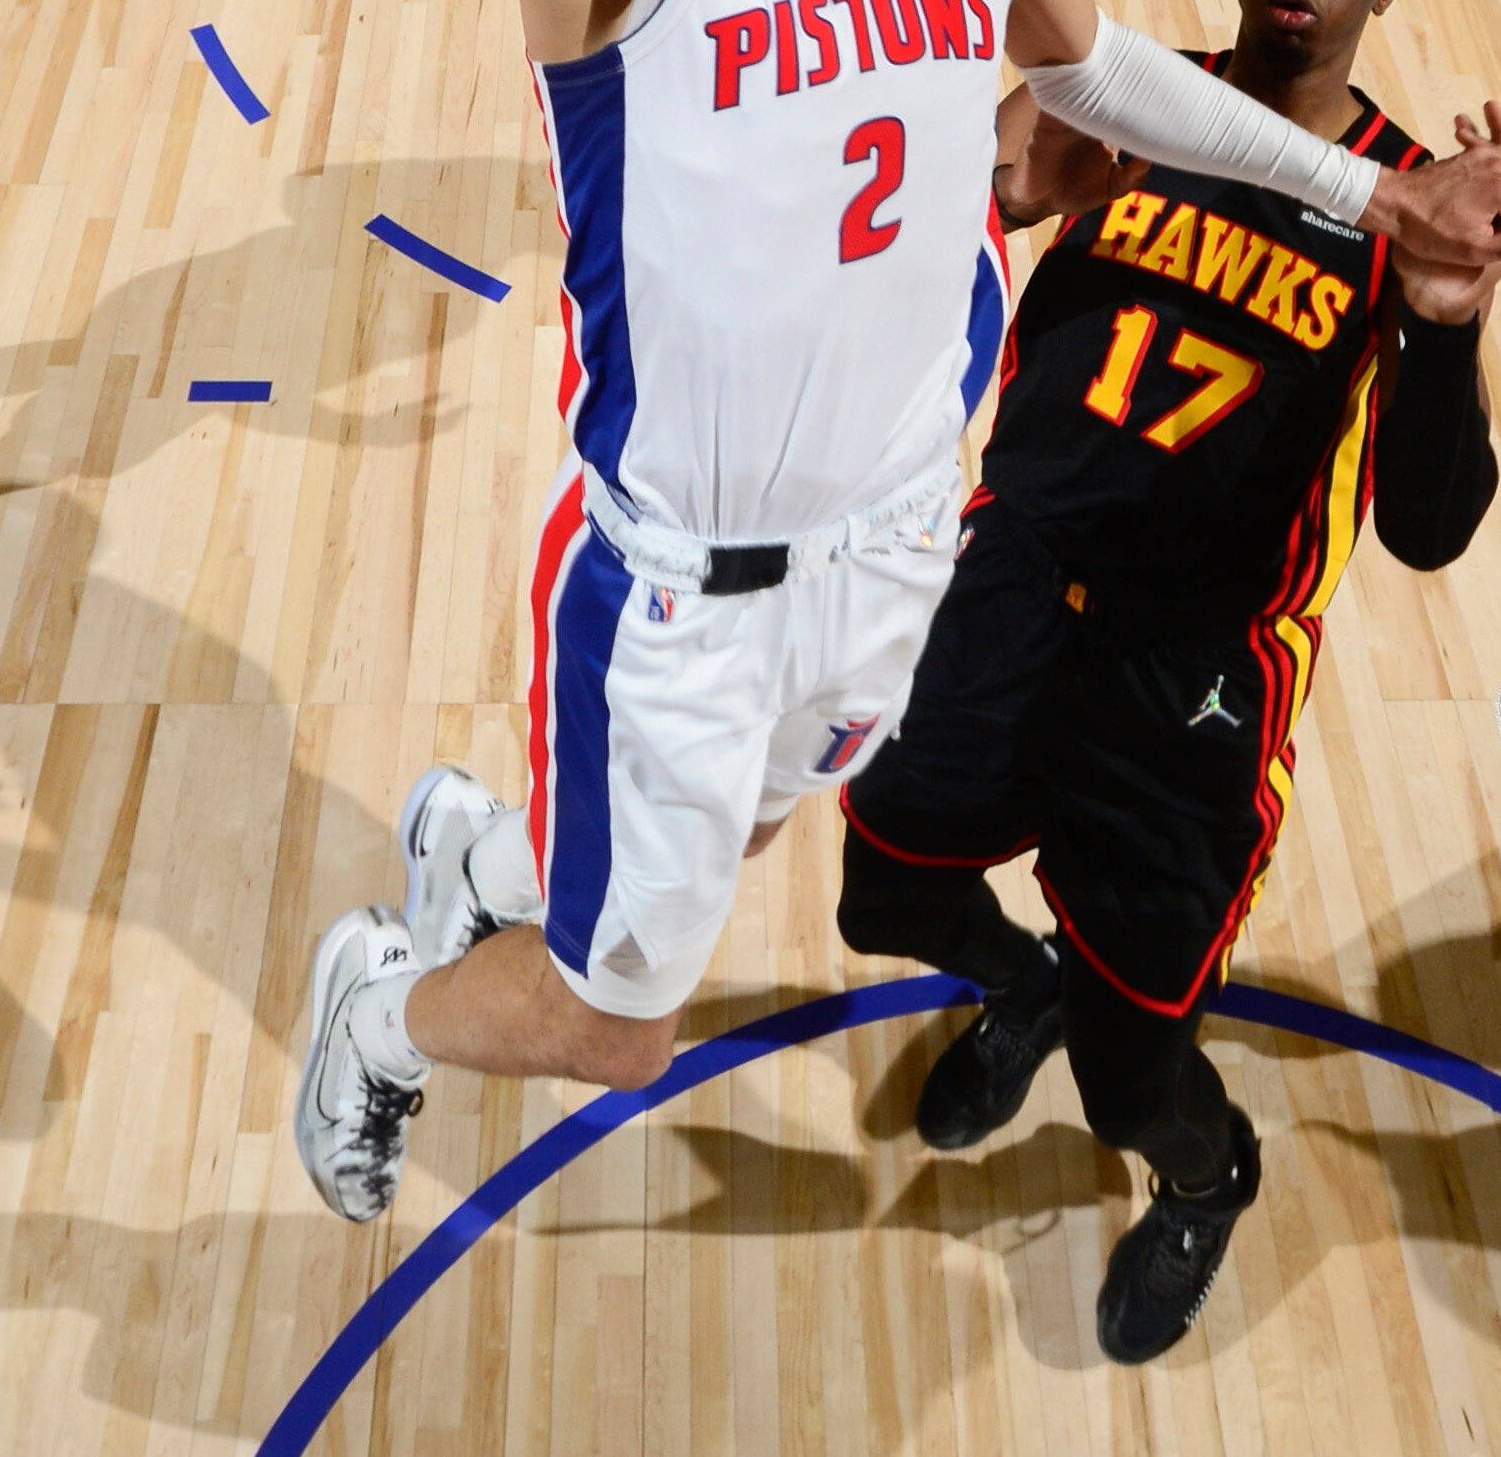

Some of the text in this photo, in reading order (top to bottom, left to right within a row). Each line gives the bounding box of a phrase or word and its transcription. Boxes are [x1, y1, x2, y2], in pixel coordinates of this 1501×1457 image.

[839, 115, 906, 265] 2
[1301, 210, 1365, 242] sharecare
[1090, 190, 1356, 353] HAWKS
[1083, 302, 1265, 454] 17
